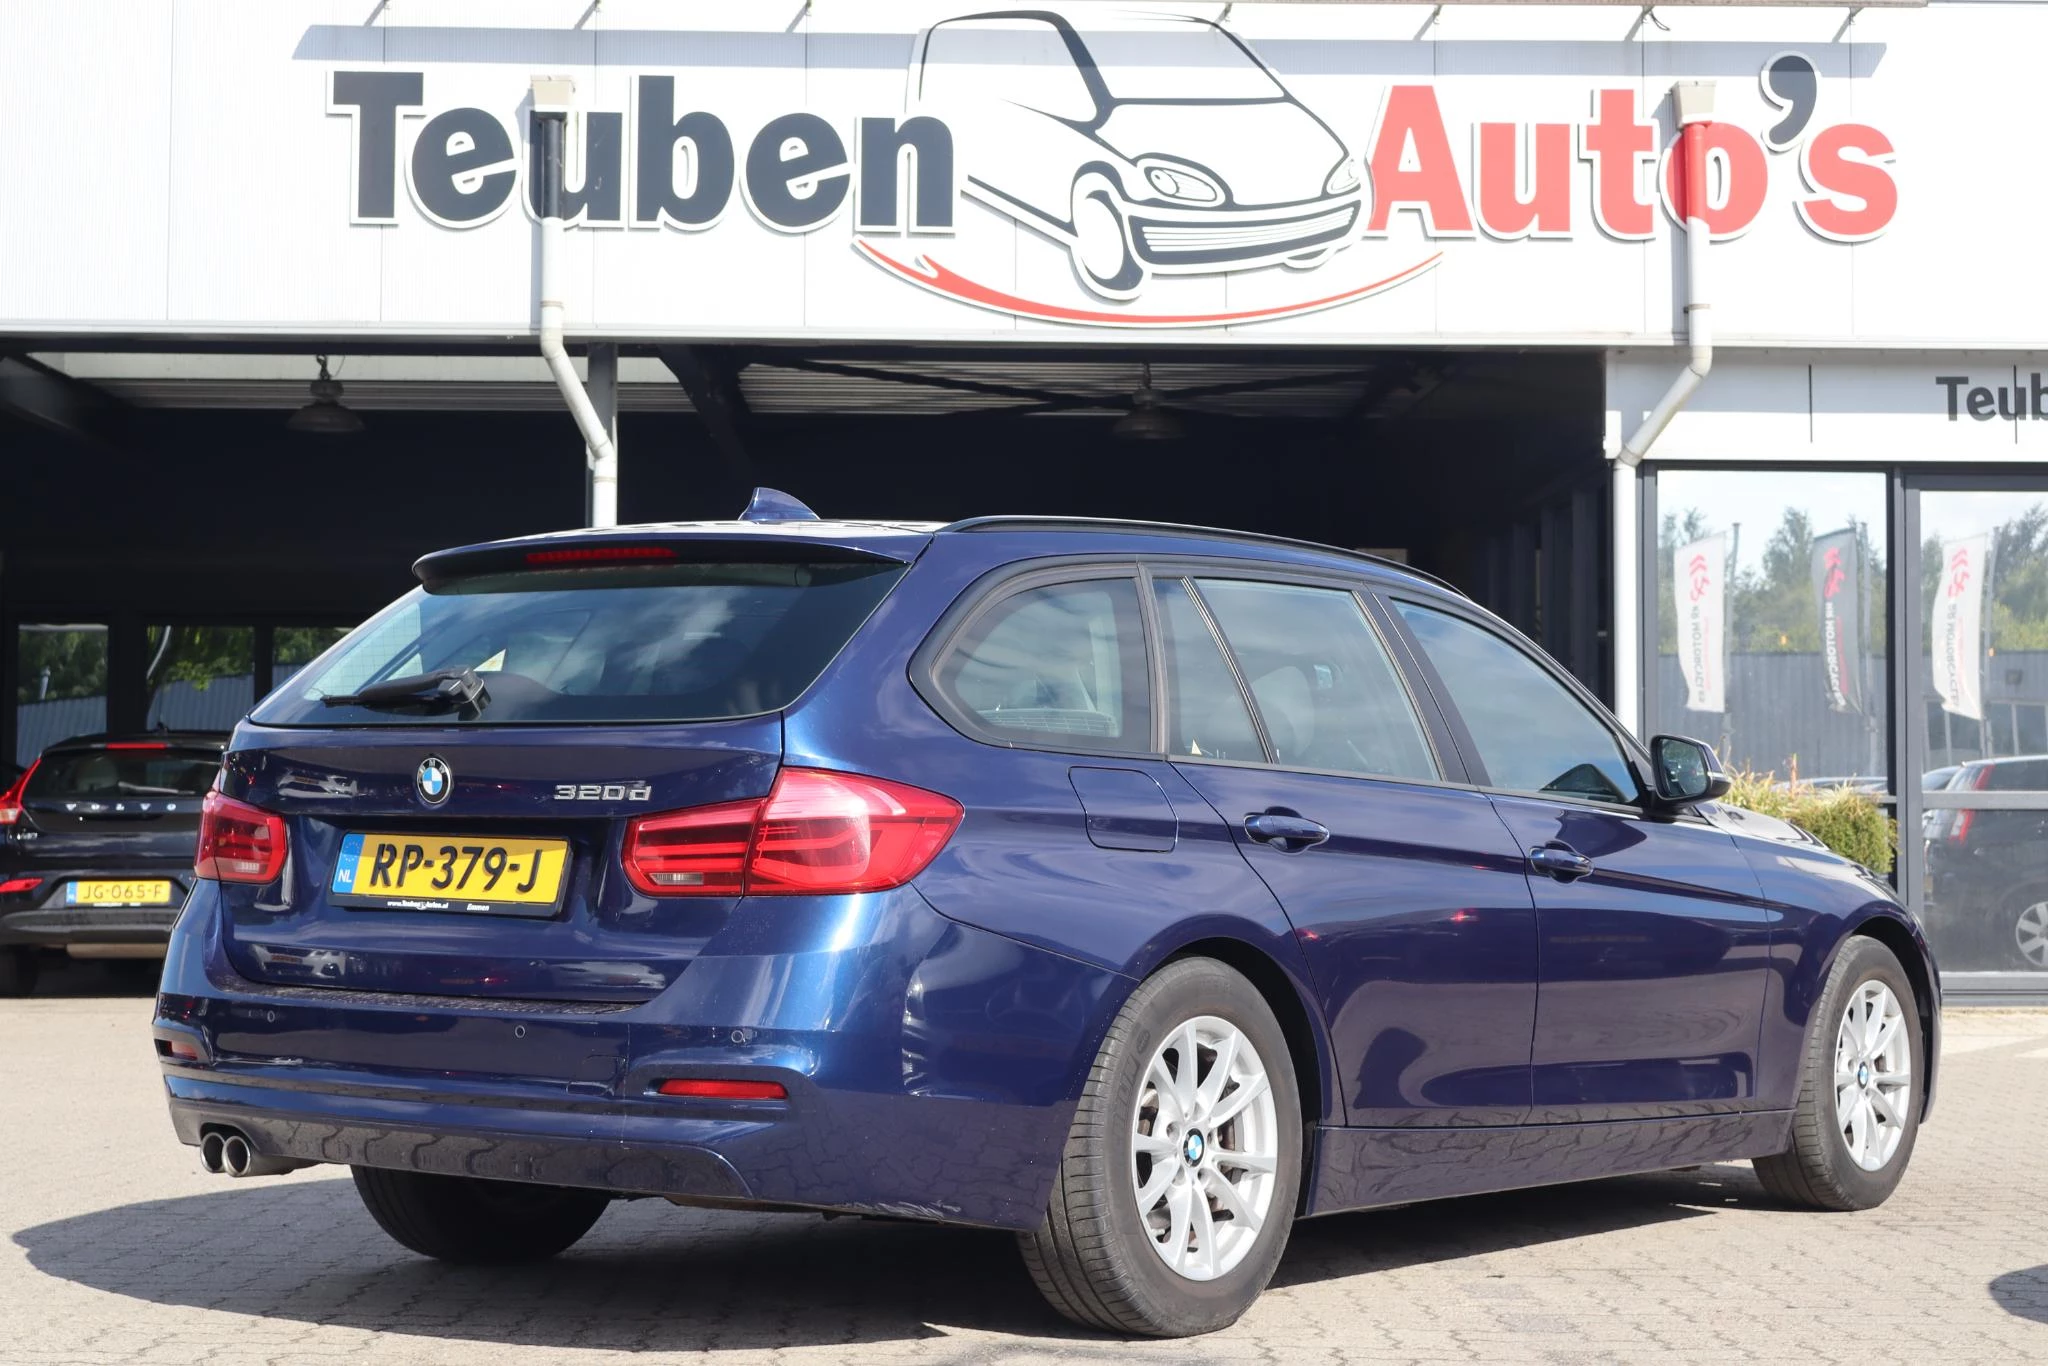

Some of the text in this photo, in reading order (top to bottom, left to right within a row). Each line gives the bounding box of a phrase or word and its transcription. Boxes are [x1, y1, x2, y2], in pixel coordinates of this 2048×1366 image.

[332, 55, 1898, 237] Teuben Auto's
[554, 784, 652, 801] 320d
[65, 803, 177, 811] VOLVO
[337, 869, 352, 883] NL
[369, 843, 544, 894] RP-379-J
[83, 884, 163, 899] JG-065-F
[467, 903, 490, 911] Emmen
